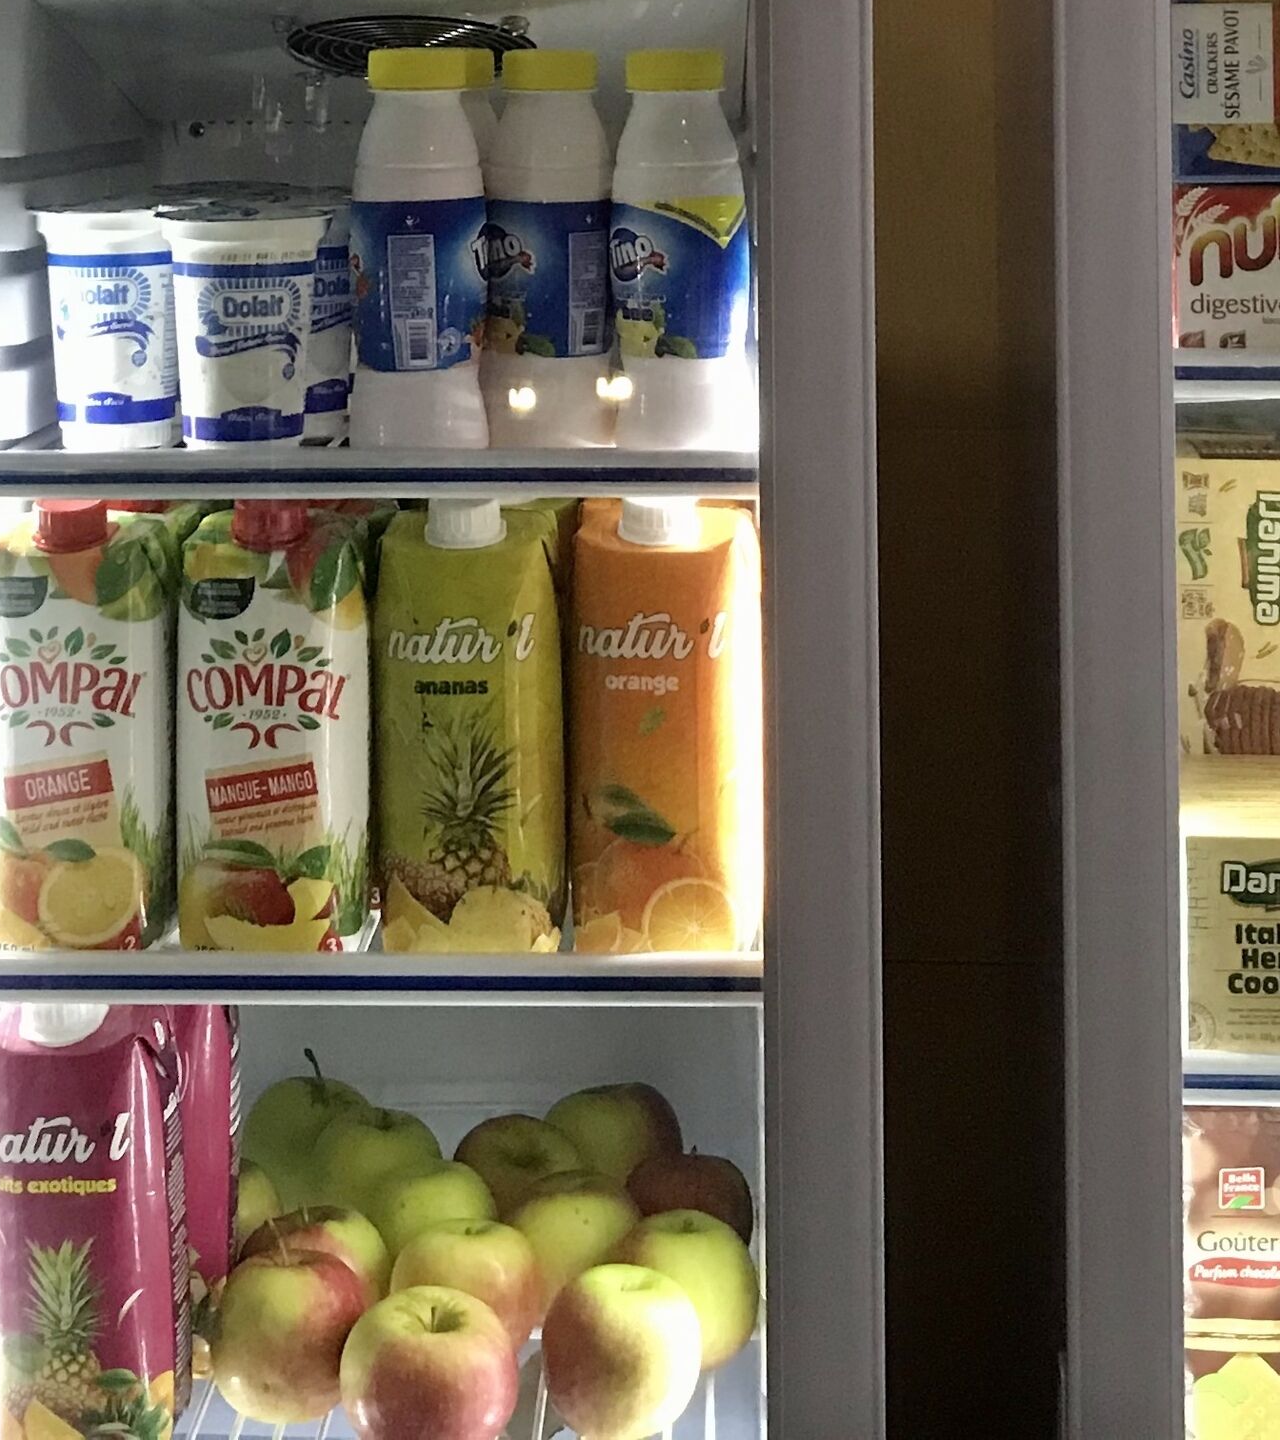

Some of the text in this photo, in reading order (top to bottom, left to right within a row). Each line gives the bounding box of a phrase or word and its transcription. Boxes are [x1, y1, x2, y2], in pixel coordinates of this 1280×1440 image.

[1223, 9, 1240, 55] PAVOT
[1178, 28, 1196, 99] Casino
[1206, 32, 1218, 94] CRACKERS
[609, 235, 654, 268] Tino
[81, 282, 130, 305] olait
[314, 276, 350, 297] Dola
[414, 678, 489, 695] ananas
[604, 673, 680, 697] orange
[248, 709, 281, 720] 1952
[24, 768, 92, 801] ORANGE
[209, 770, 314, 807] MANGUE-MANGO
[27, 1176, 117, 1196] exotiques
[1223, 1183, 1261, 1194] France
[1227, 1173, 1257, 1184] Belle
[1194, 1263, 1239, 1282] Parfum
